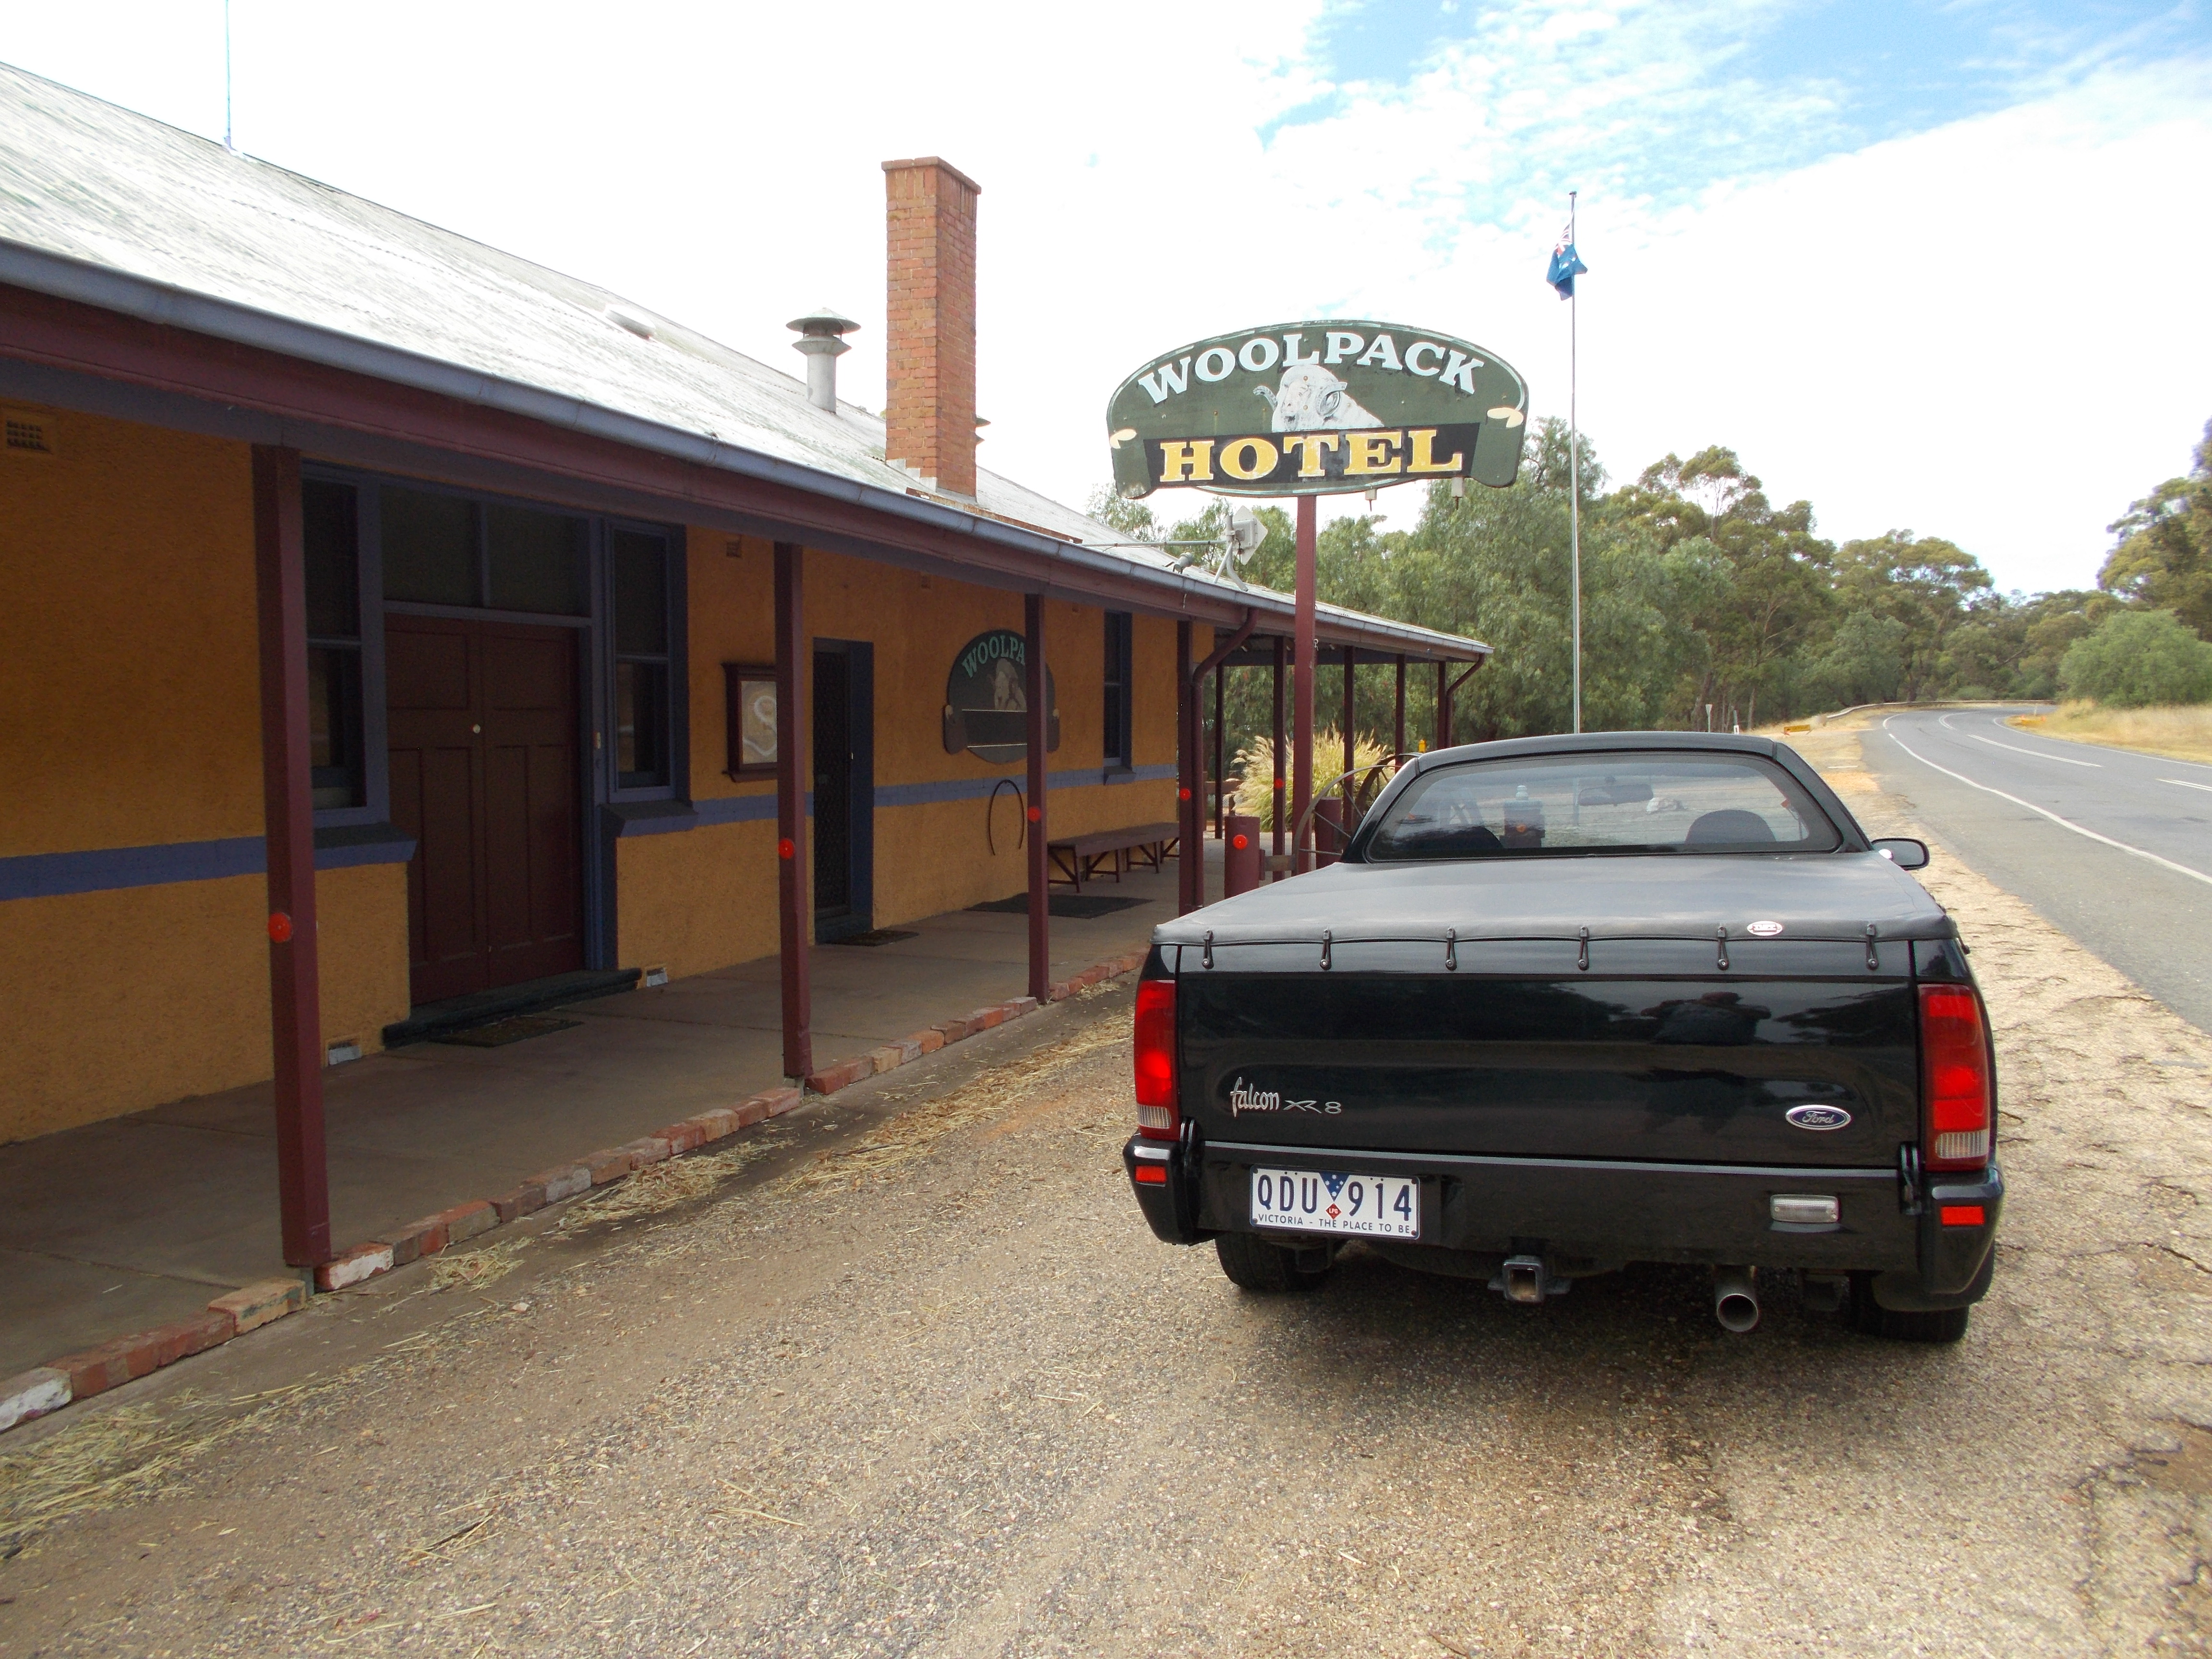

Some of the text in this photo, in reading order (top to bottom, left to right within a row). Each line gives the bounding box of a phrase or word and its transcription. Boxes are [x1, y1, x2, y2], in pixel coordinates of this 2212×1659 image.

[1137, 331, 1484, 405] WOOLPACK
[1160, 429, 1463, 482] HOTEL
[961, 635, 1025, 678] WOOLPA
[1802, 1110, 1835, 1124] Ford
[1257, 1174, 1412, 1221] QDU 914
[1258, 1213, 1303, 1226] VICTORIA
[1319, 1218, 1337, 1228] THE
[1343, 1220, 1373, 1231] PLACE
[1379, 1223, 1392, 1232] TO
[1398, 1225, 1410, 1234] BE
